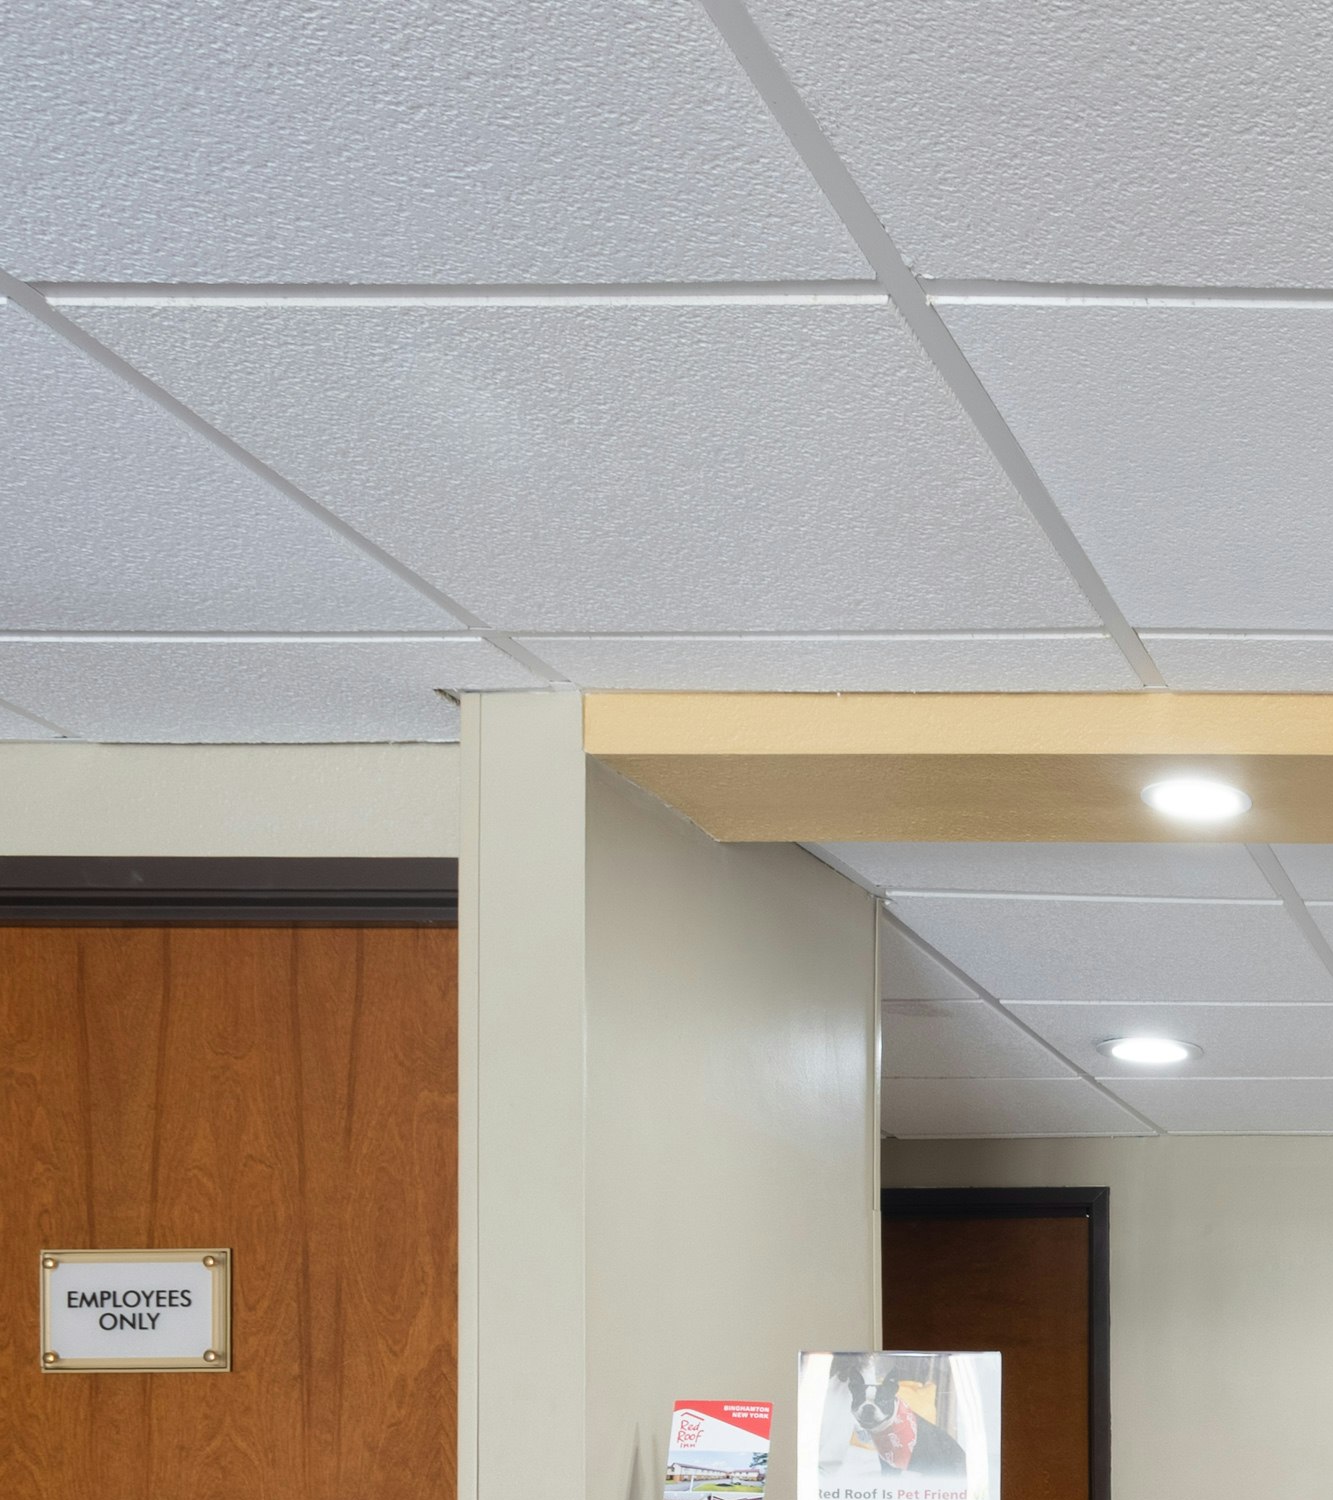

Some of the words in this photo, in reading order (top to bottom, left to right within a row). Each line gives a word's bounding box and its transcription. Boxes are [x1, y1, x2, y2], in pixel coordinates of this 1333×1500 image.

[67, 1290, 192, 1309] EMPLOYEES
[99, 1312, 160, 1330] ONLY
[724, 1405, 769, 1413] BINGHAMTON
[680, 1420, 701, 1431] Red
[677, 1430, 704, 1443] Roof
[845, 1488, 877, 1500] Roof
[882, 1490, 893, 1500] Is
[897, 1489, 920, 1500] Pet
